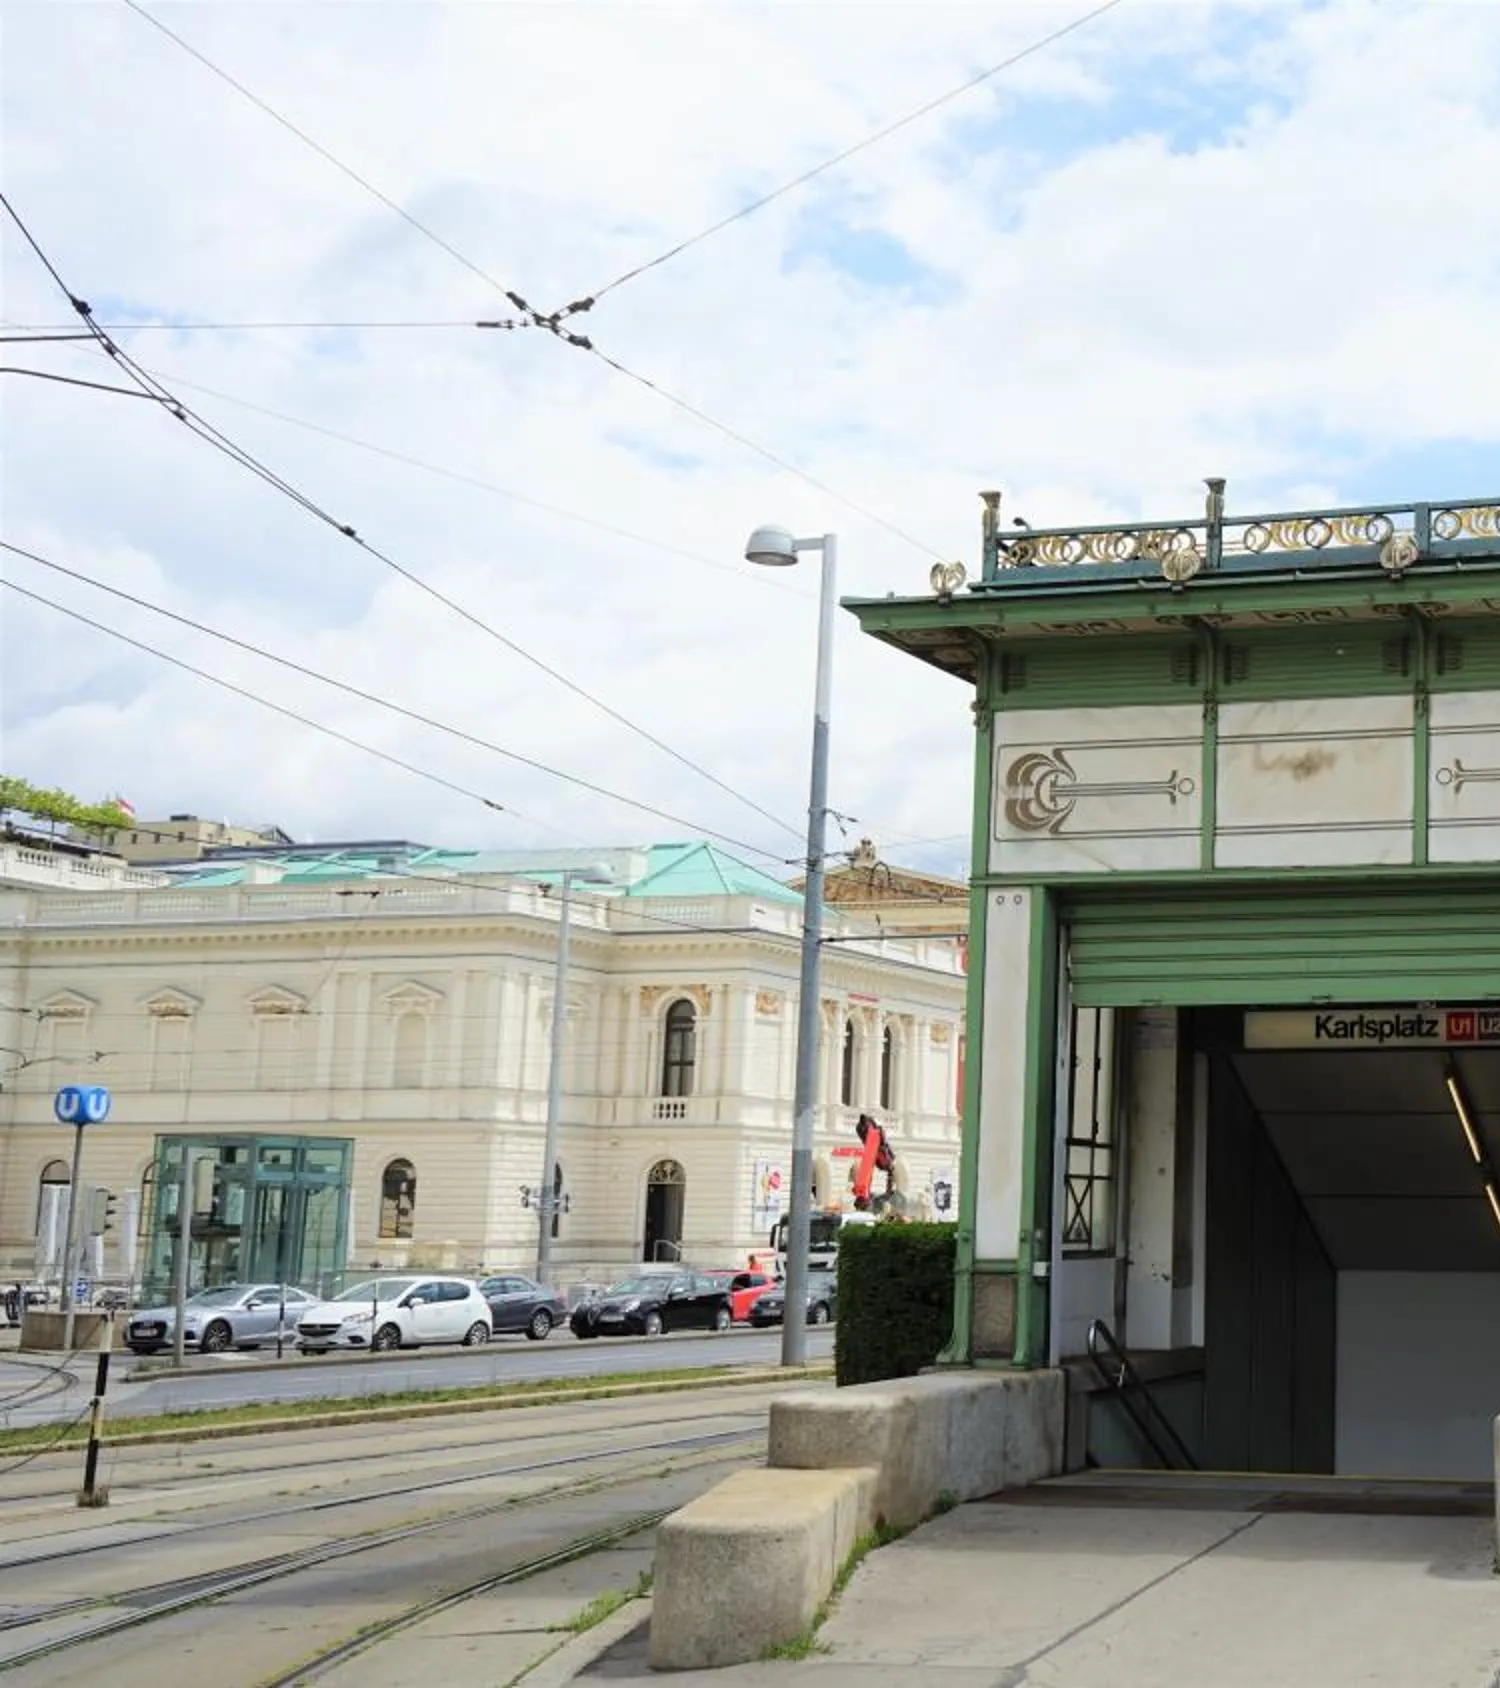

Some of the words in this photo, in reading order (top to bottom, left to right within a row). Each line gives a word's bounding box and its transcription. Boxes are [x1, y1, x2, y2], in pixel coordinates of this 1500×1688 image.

[1315, 1013, 1439, 1042] Karlsplatz
[1450, 1015, 1471, 1034] U1
[58, 1092, 78, 1119] U
[88, 1092, 108, 1119] U
